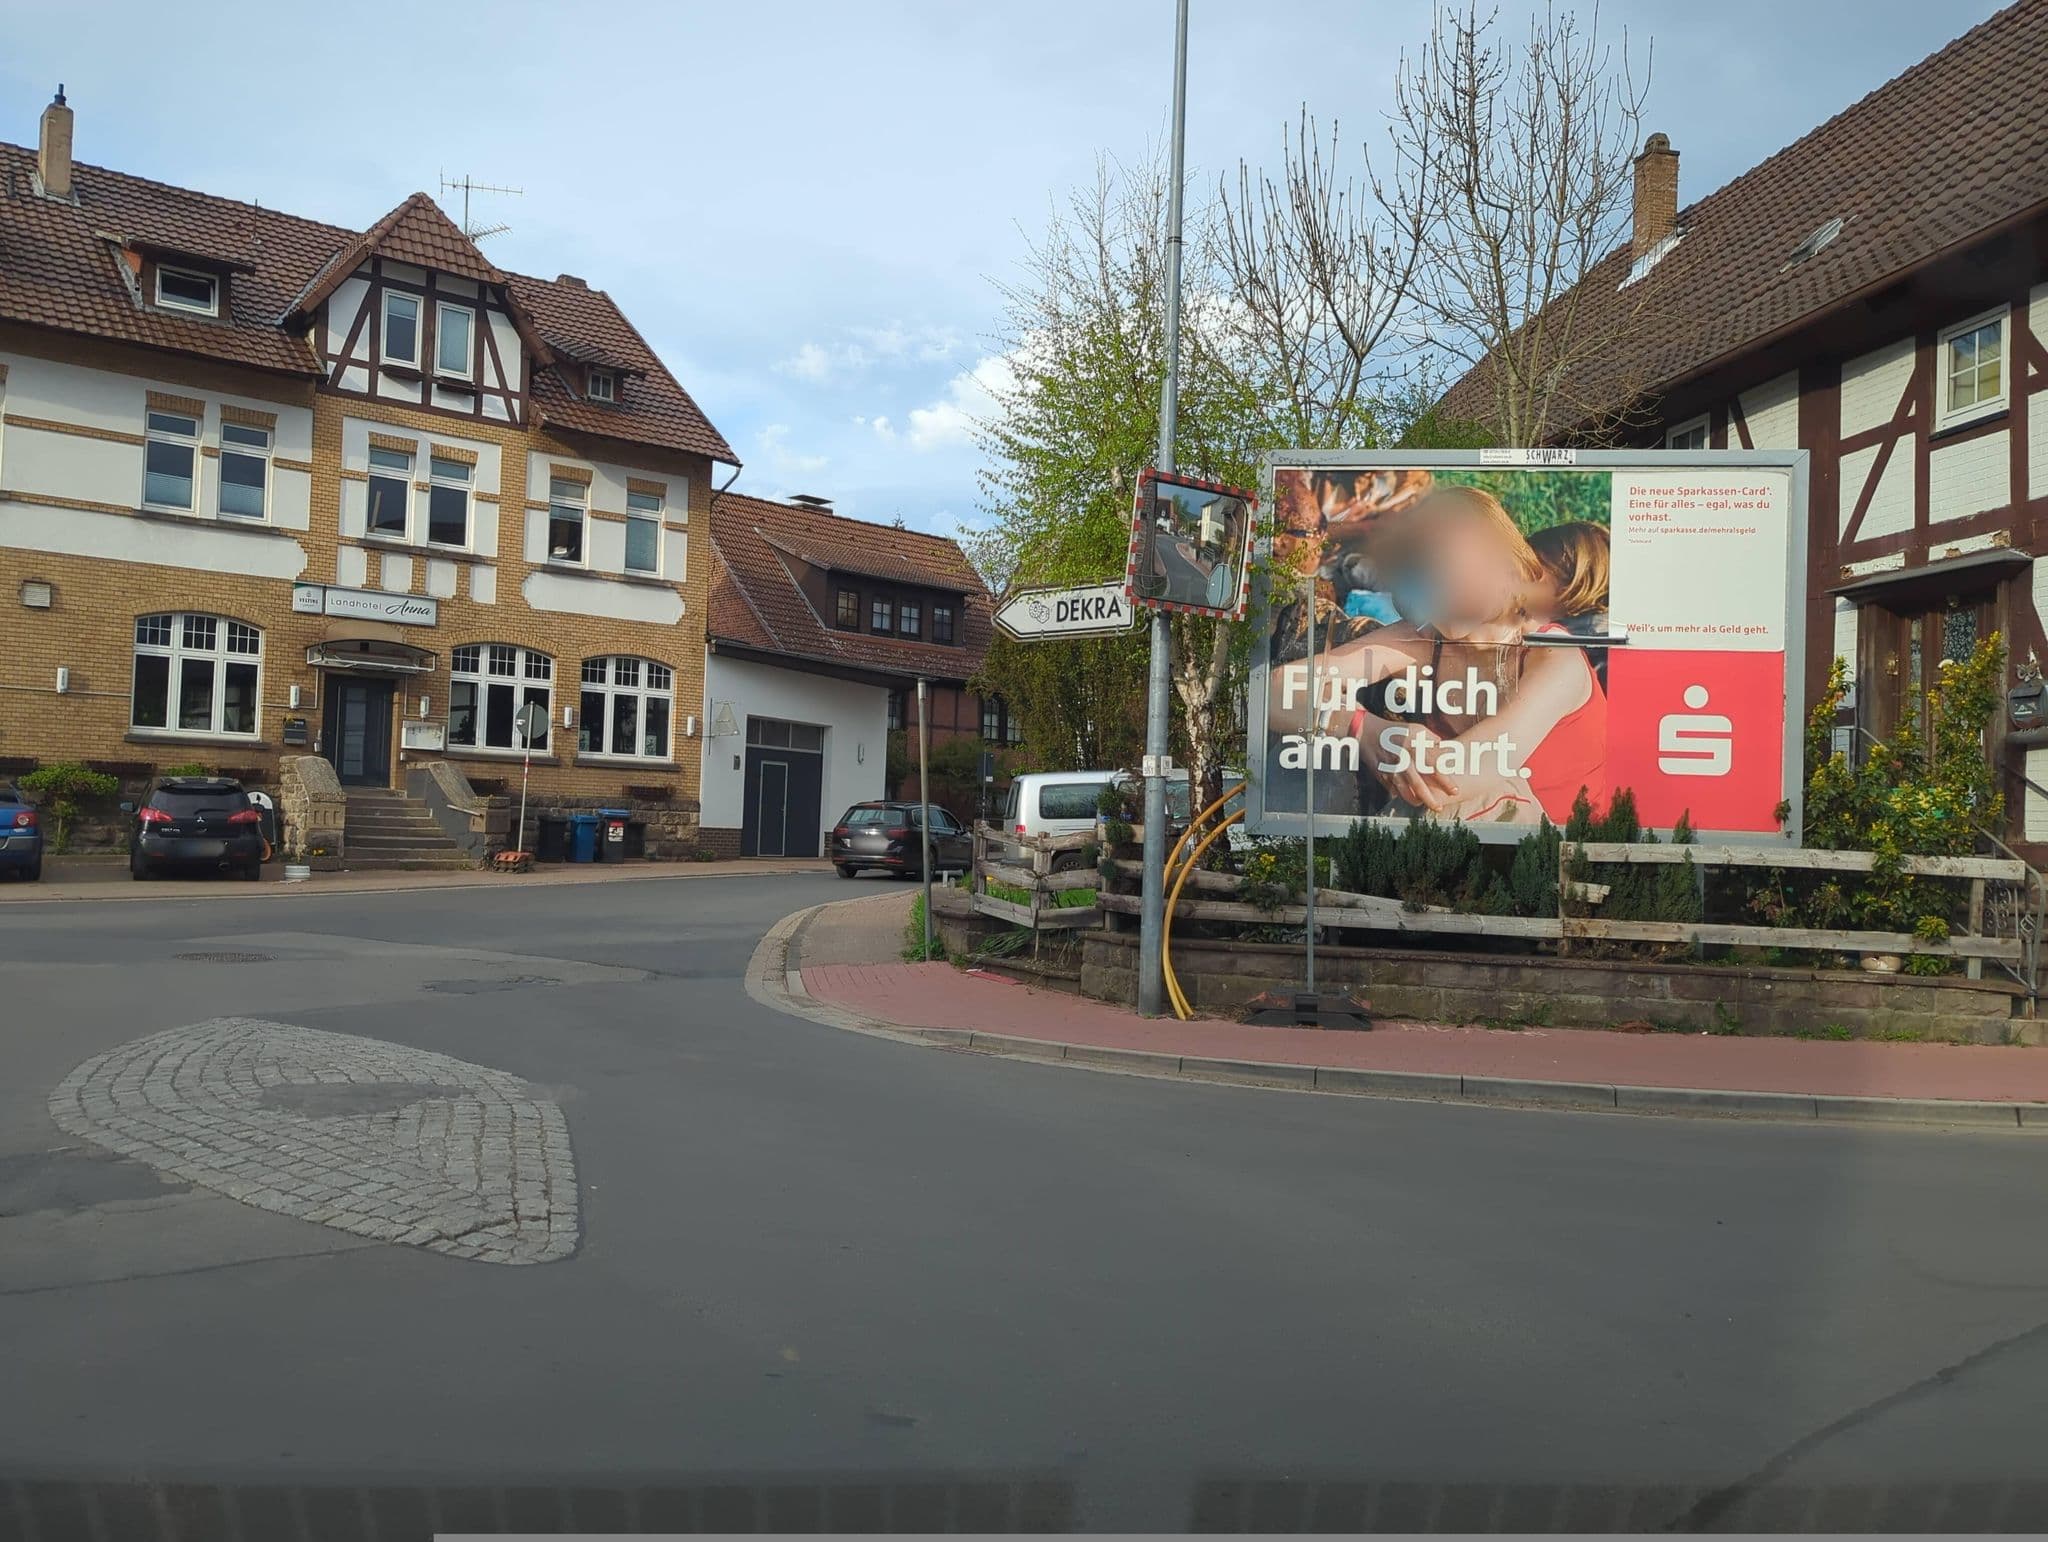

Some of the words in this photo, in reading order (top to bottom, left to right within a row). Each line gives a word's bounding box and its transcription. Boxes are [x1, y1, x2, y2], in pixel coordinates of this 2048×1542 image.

[1630, 486, 1647, 496] Die
[1650, 488, 1674, 496] neue
[1629, 499, 1651, 509] Eine
[1654, 499, 1668, 509] für
[1671, 499, 1695, 509] alles
[1706, 499, 1731, 511] egal,
[1756, 499, 1770, 509] du
[1629, 512, 1672, 522] vorhast.
[1629, 526, 1647, 534] Mehr
[1648, 526, 1660, 534] auf
[330, 597, 382, 610] Landhotel
[385, 599, 432, 616] Anna
[1056, 596, 1122, 623] DEKRA
[1626, 623, 1655, 633] Weil's
[1657, 625, 1672, 633] um
[1675, 624, 1700, 633] mehr
[1702, 624, 1717, 633] als
[1719, 624, 1741, 634] Geld
[1743, 625, 1769, 636] geht.
[1282, 664, 1368, 712] Für
[1384, 665, 1498, 716] dich
[1278, 734, 1360, 771] am
[1377, 726, 1532, 779] Start.
